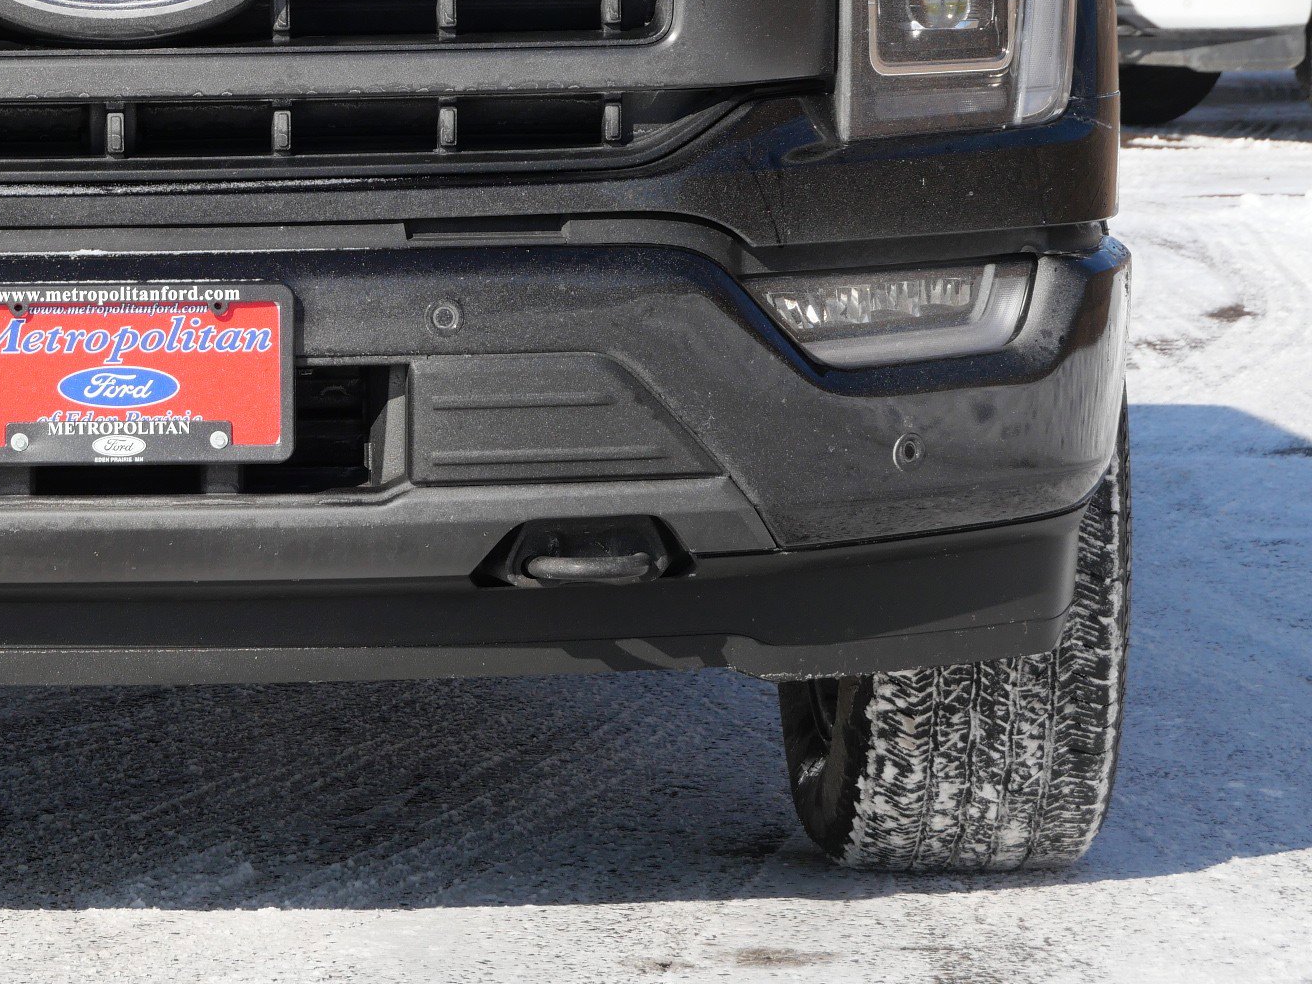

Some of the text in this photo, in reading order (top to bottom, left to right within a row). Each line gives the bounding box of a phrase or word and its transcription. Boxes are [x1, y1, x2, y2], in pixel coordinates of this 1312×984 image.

[29, 303, 208, 316] www.metropolitanford.com
[83, 372, 152, 400] Ford
[48, 422, 190, 435] METROPOLITAN
[104, 439, 134, 452] Ford
